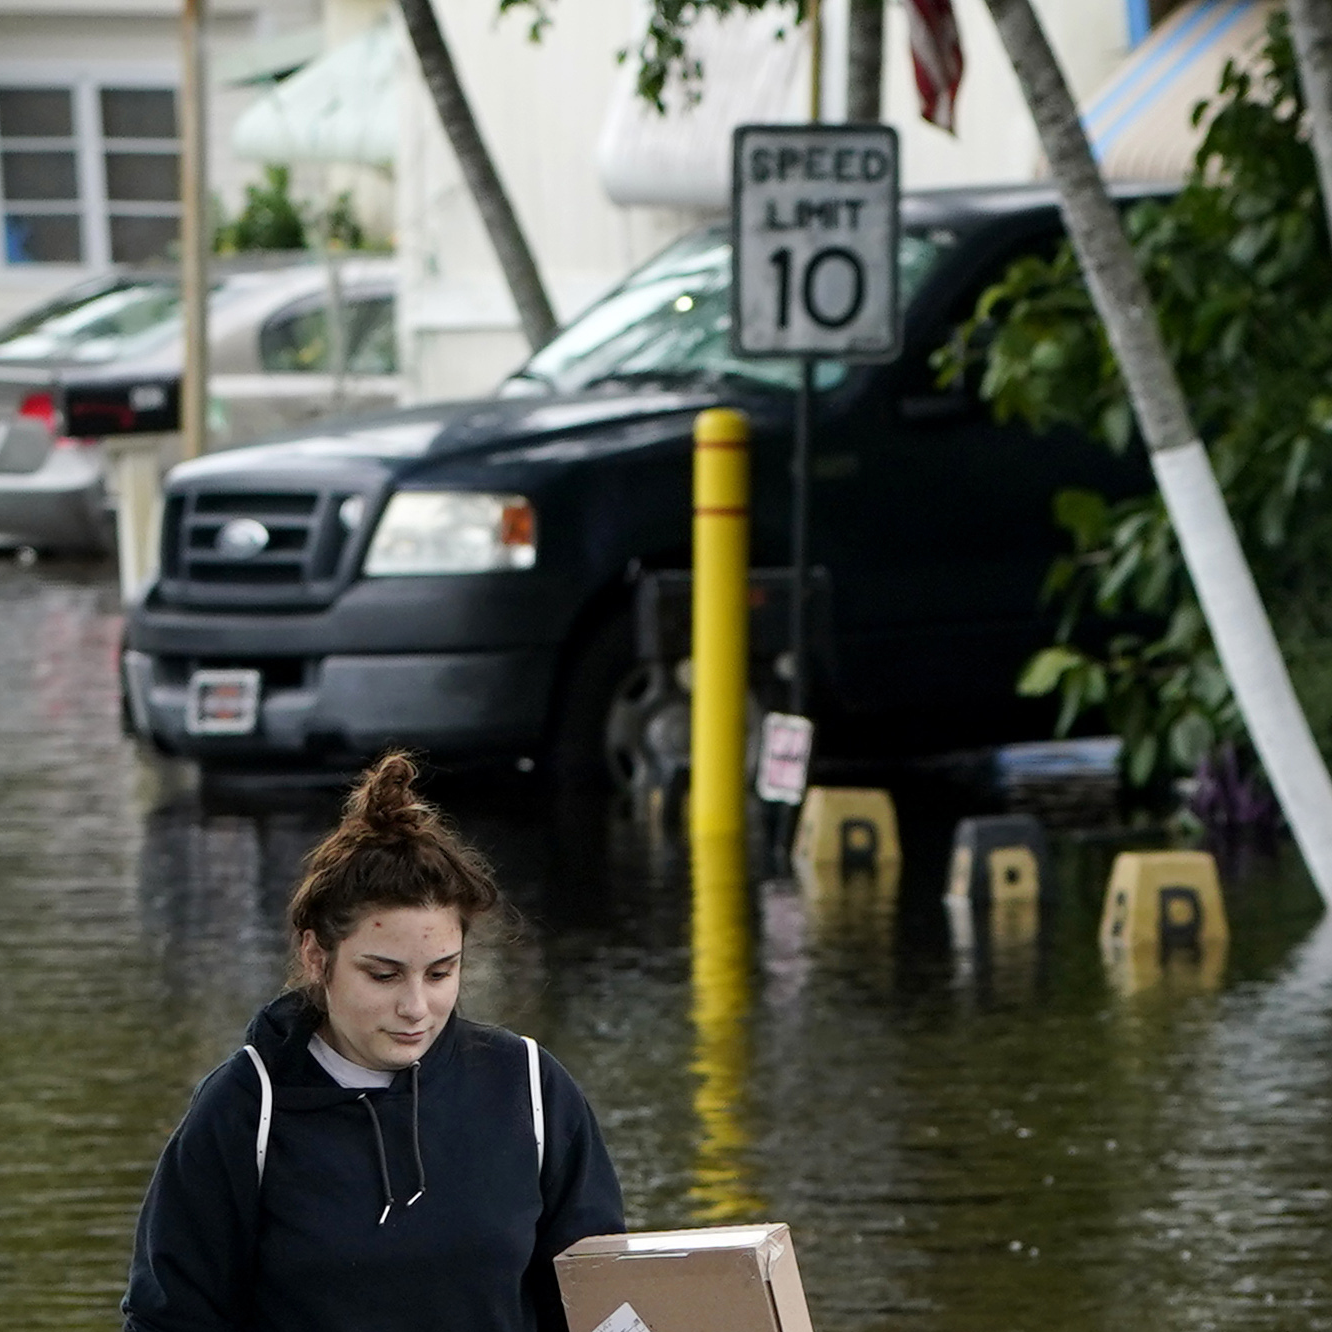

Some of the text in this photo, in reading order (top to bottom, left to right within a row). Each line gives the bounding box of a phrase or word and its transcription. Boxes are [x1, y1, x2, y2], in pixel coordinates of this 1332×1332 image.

[751, 147, 888, 184] SPEED
[765, 199, 864, 231] LIMIT
[769, 246, 866, 330] 10
